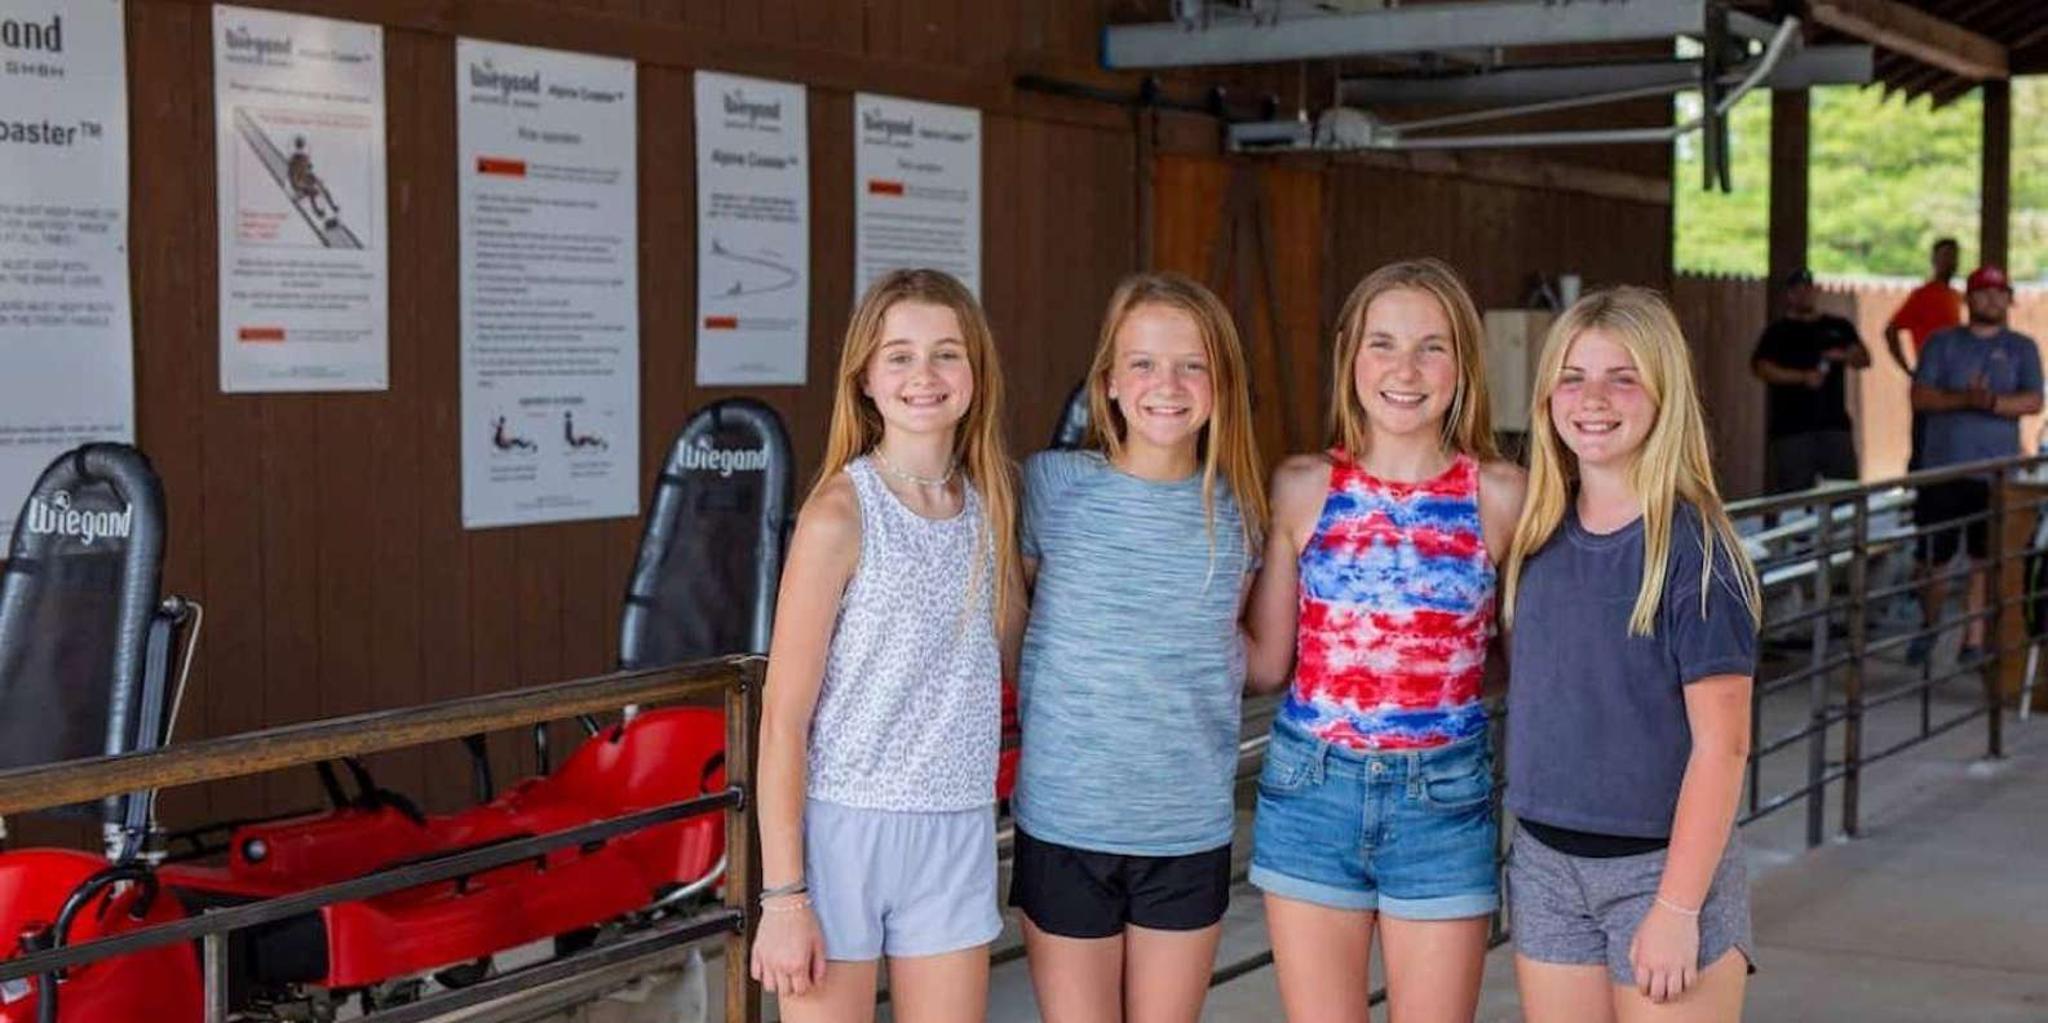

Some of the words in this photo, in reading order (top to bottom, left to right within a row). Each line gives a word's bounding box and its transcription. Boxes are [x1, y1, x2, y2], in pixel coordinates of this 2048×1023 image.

[470, 58, 540, 97] Wiegand
[677, 434, 769, 478] Wiegand
[28, 490, 133, 545] Wiegand
